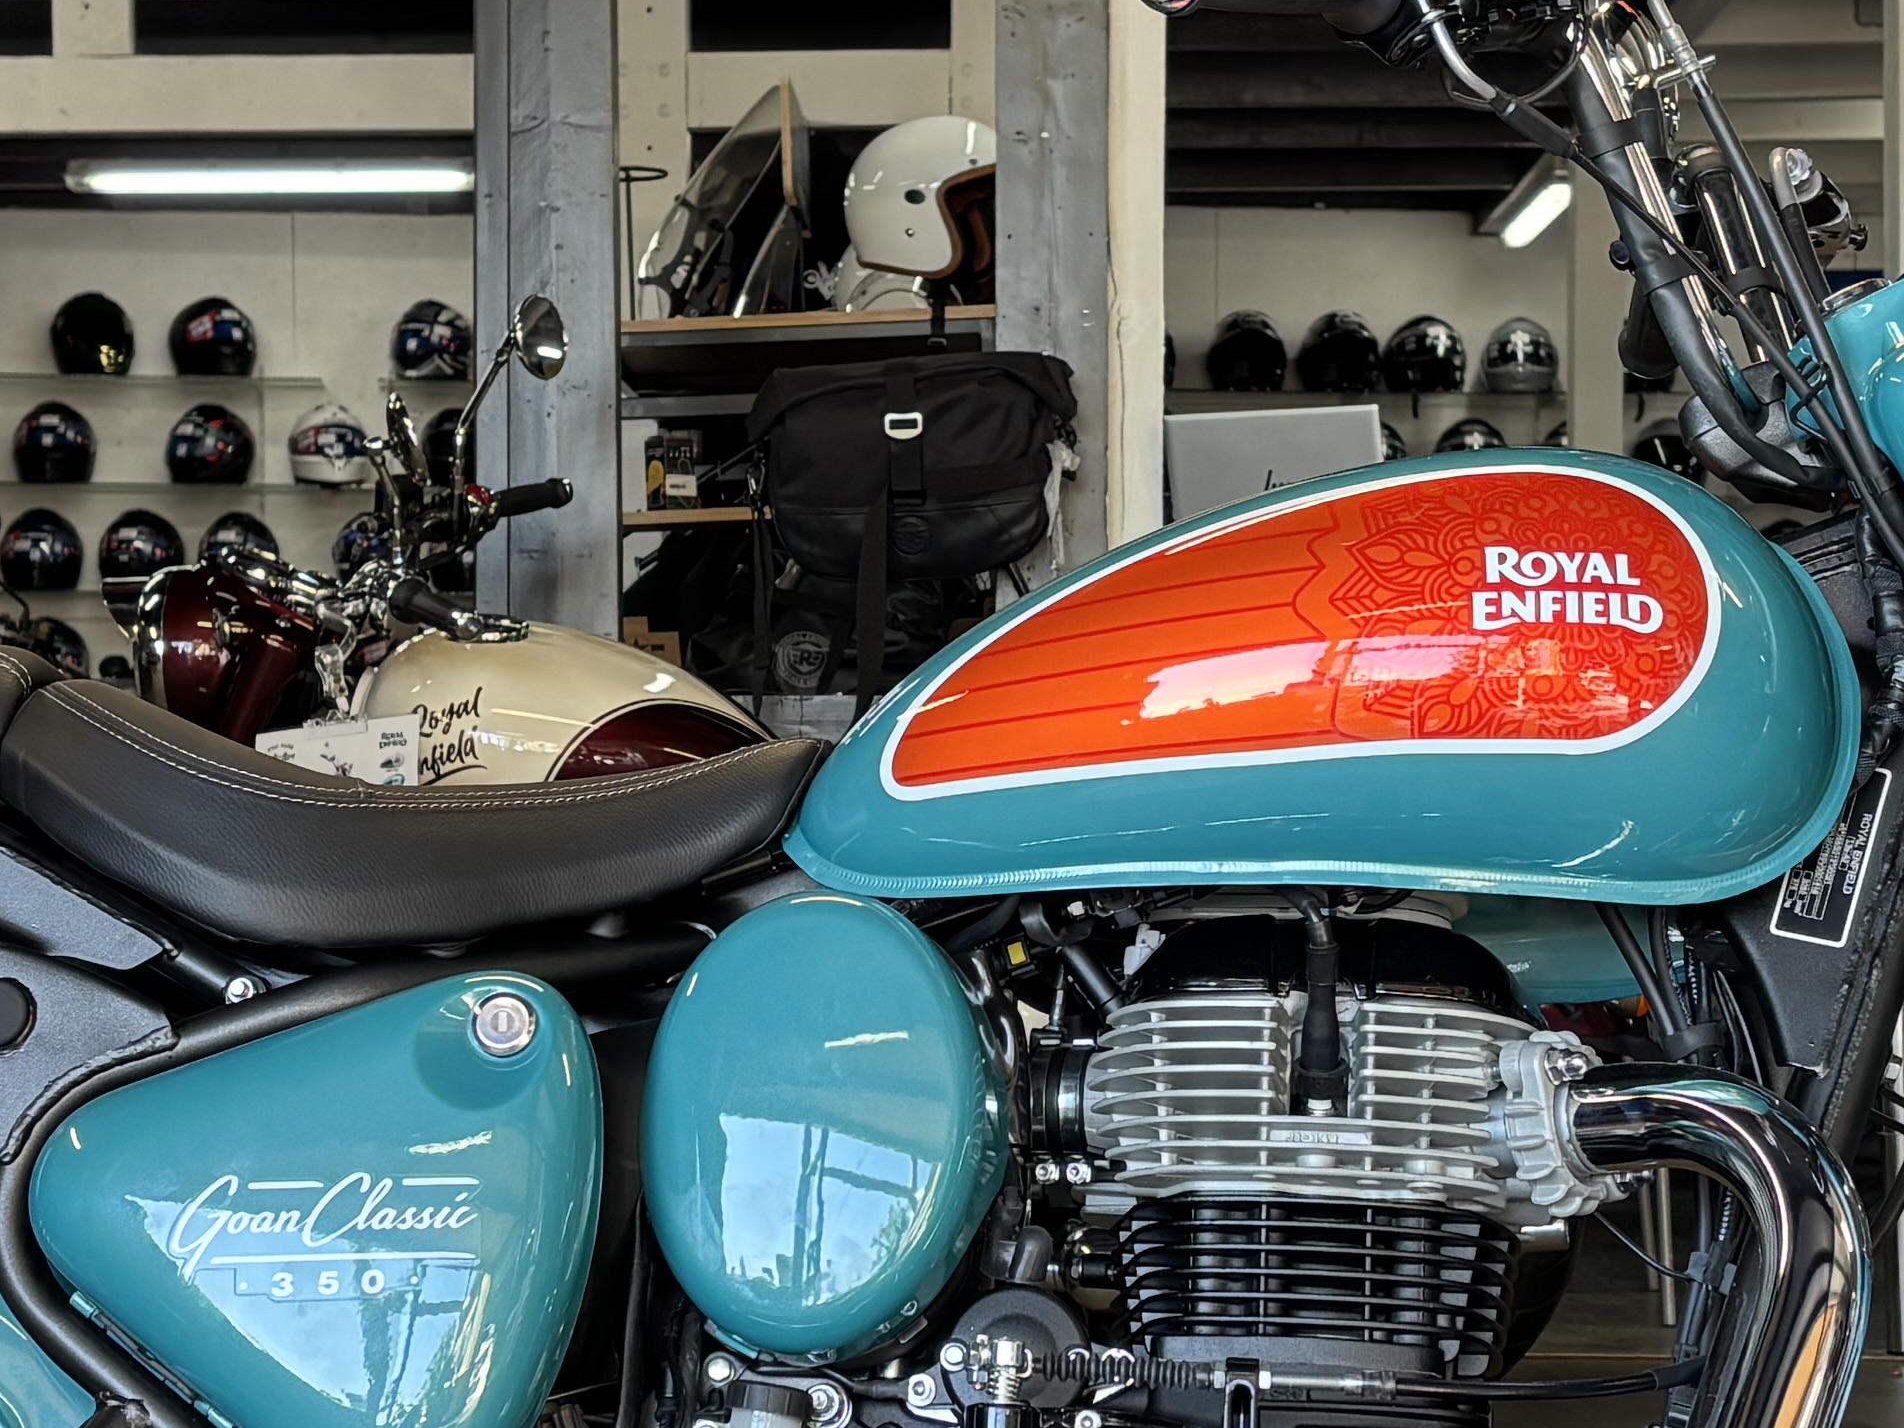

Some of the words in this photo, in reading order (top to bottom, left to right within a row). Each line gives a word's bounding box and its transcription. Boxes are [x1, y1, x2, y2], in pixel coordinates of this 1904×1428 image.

[1485, 545, 1642, 586] ROYAL
[1472, 590, 1664, 633] ENFIELD
[412, 686, 483, 738] Royal
[419, 725, 480, 778] nfield
[1854, 813, 1873, 848] ROYAL
[1842, 849, 1863, 895] ENFIELD
[169, 1174, 301, 1285] Goan
[302, 1172, 479, 1248] Classic
